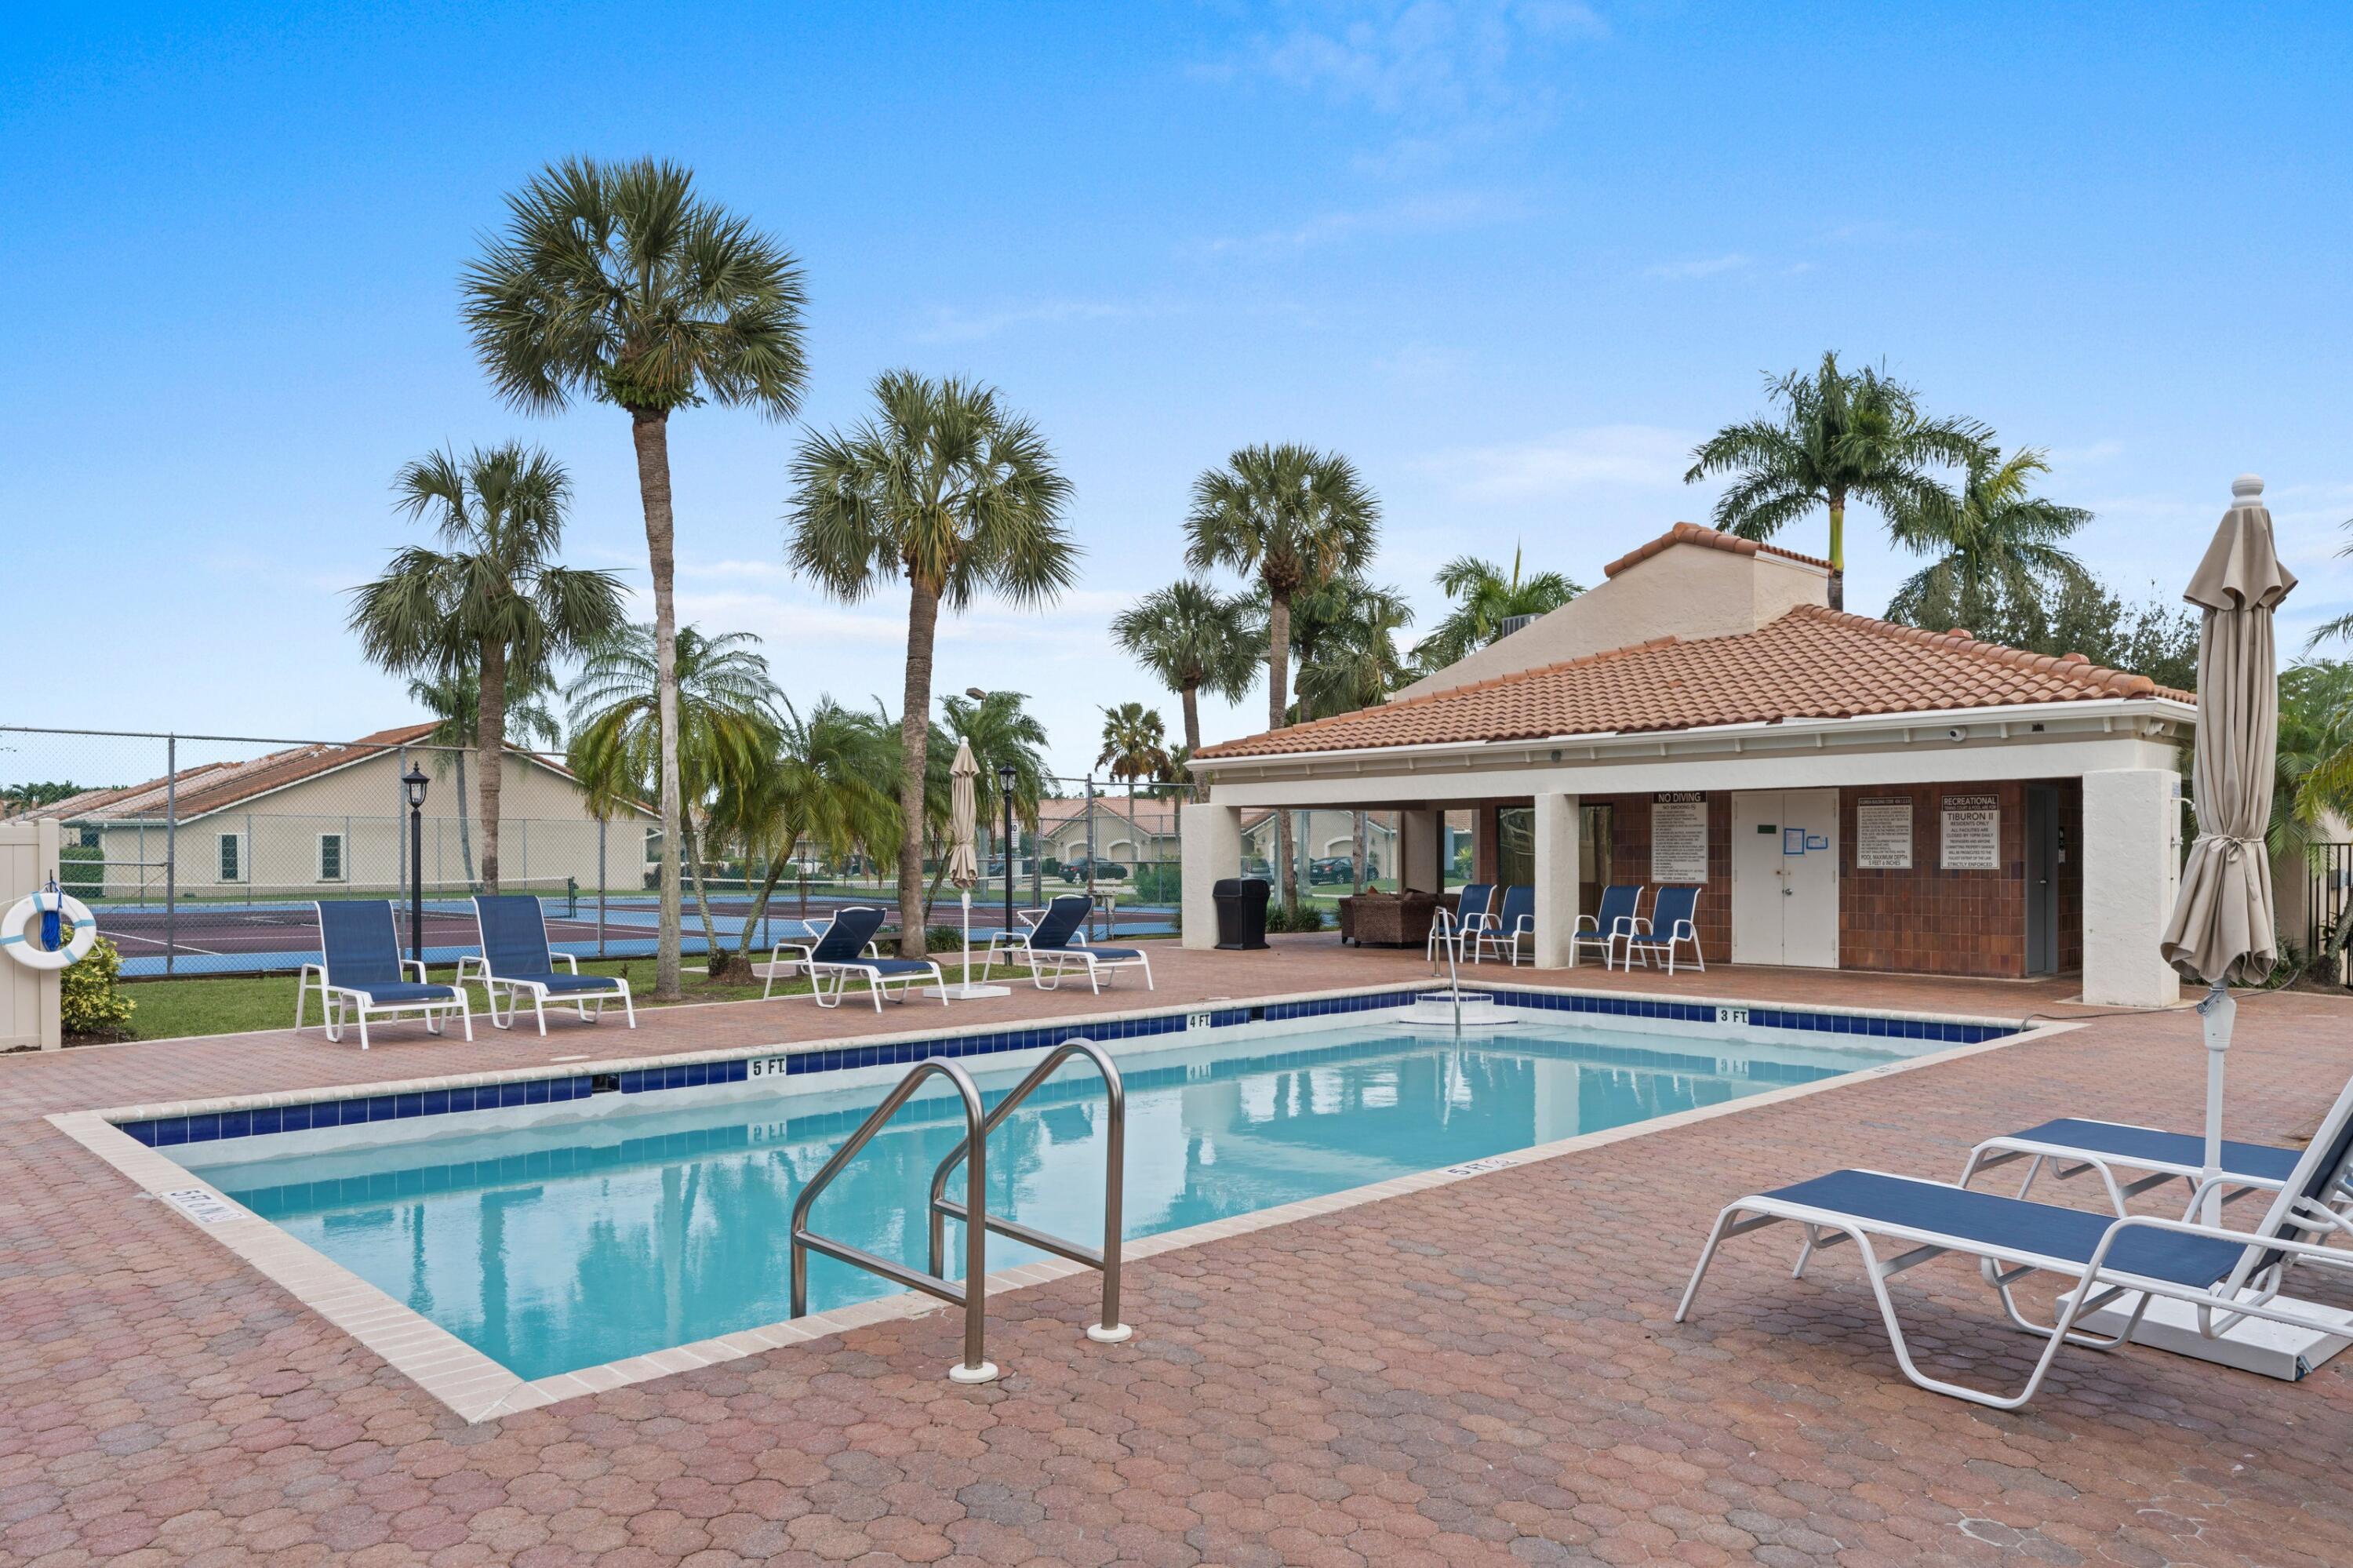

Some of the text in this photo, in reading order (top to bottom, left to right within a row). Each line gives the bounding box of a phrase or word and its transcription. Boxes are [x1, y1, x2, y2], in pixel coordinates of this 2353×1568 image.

[1658, 792, 1701, 802] NO DIVING
[1944, 797, 1996, 806] RECREATIONAL
[1947, 813, 1986, 821] TIBURON
[1721, 1010, 1728, 1021] 3
[1190, 1016, 1195, 1028] 4
[753, 1060, 762, 1075] 5
